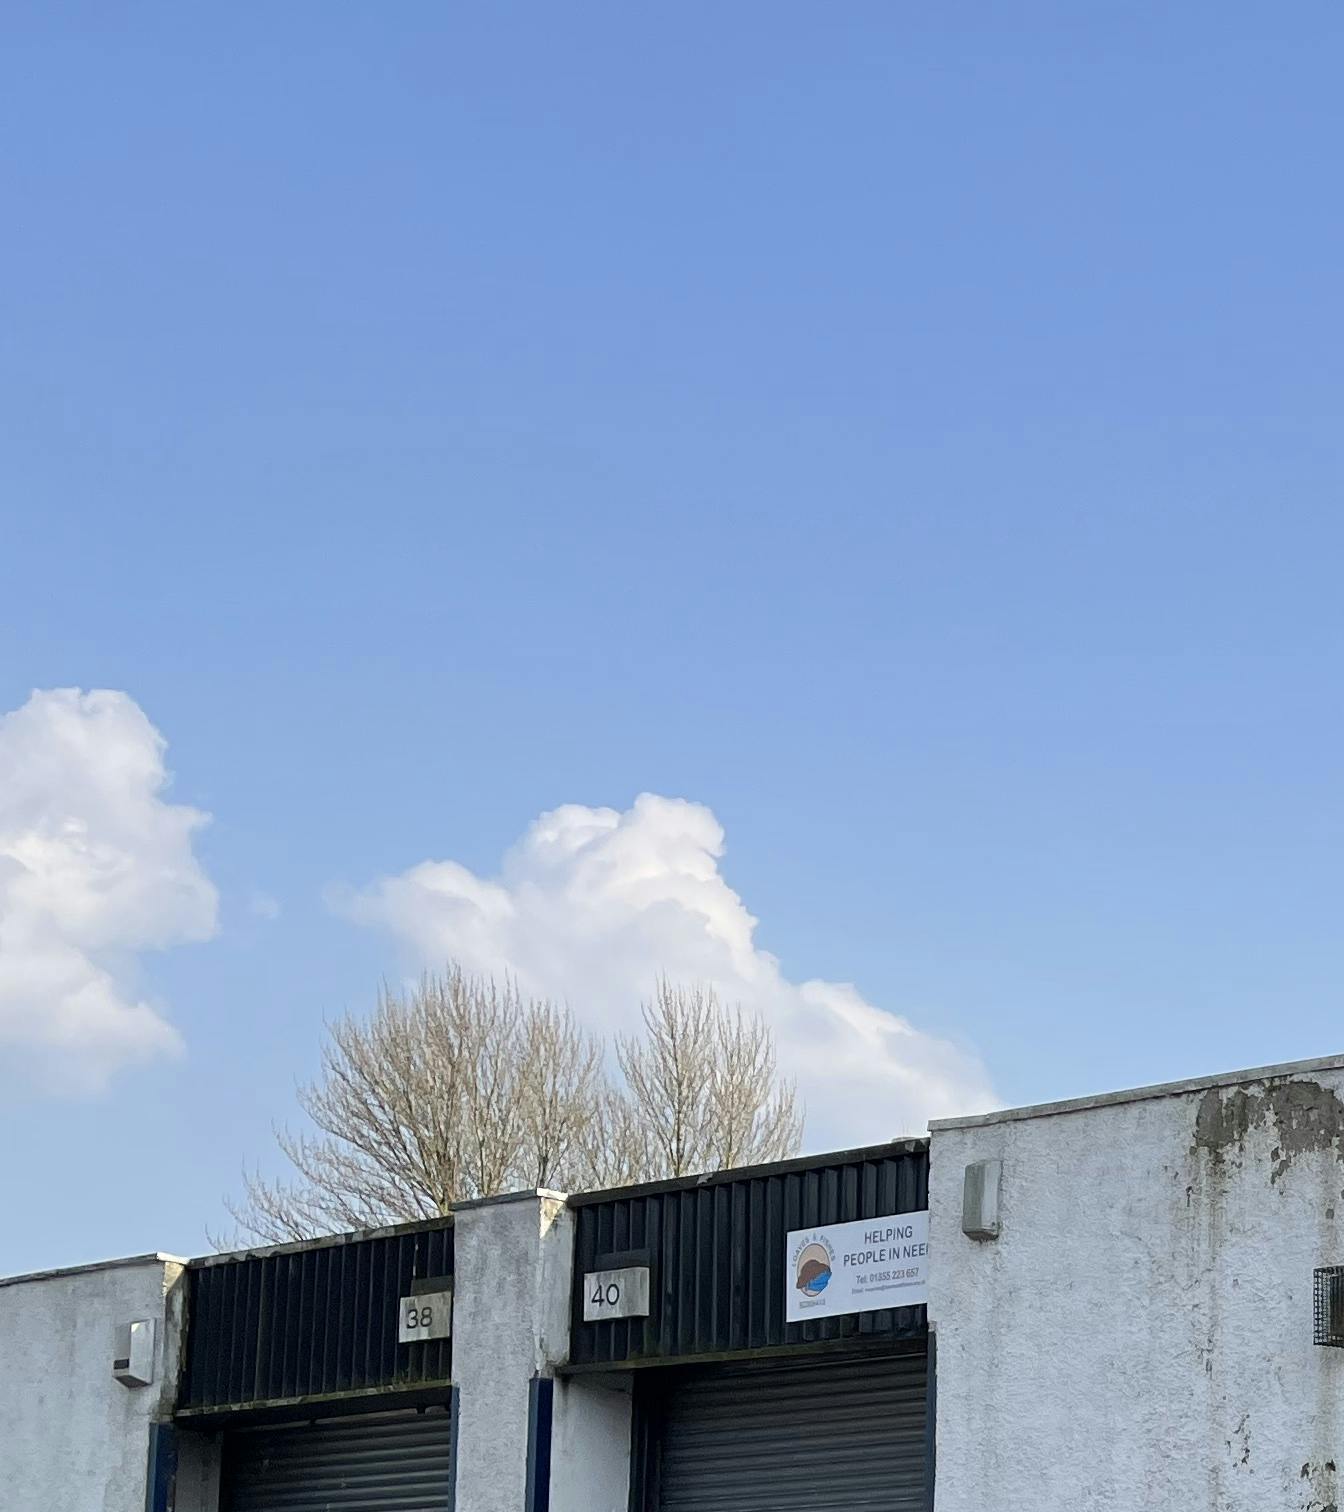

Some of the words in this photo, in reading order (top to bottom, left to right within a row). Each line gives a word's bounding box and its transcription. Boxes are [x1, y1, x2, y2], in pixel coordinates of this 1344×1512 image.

[864, 1225, 913, 1244] HELPING
[843, 1248, 886, 1267] PEOPLE
[889, 1246, 900, 1260] IN
[591, 1283, 620, 1306] 40
[406, 1306, 432, 1329] 38
